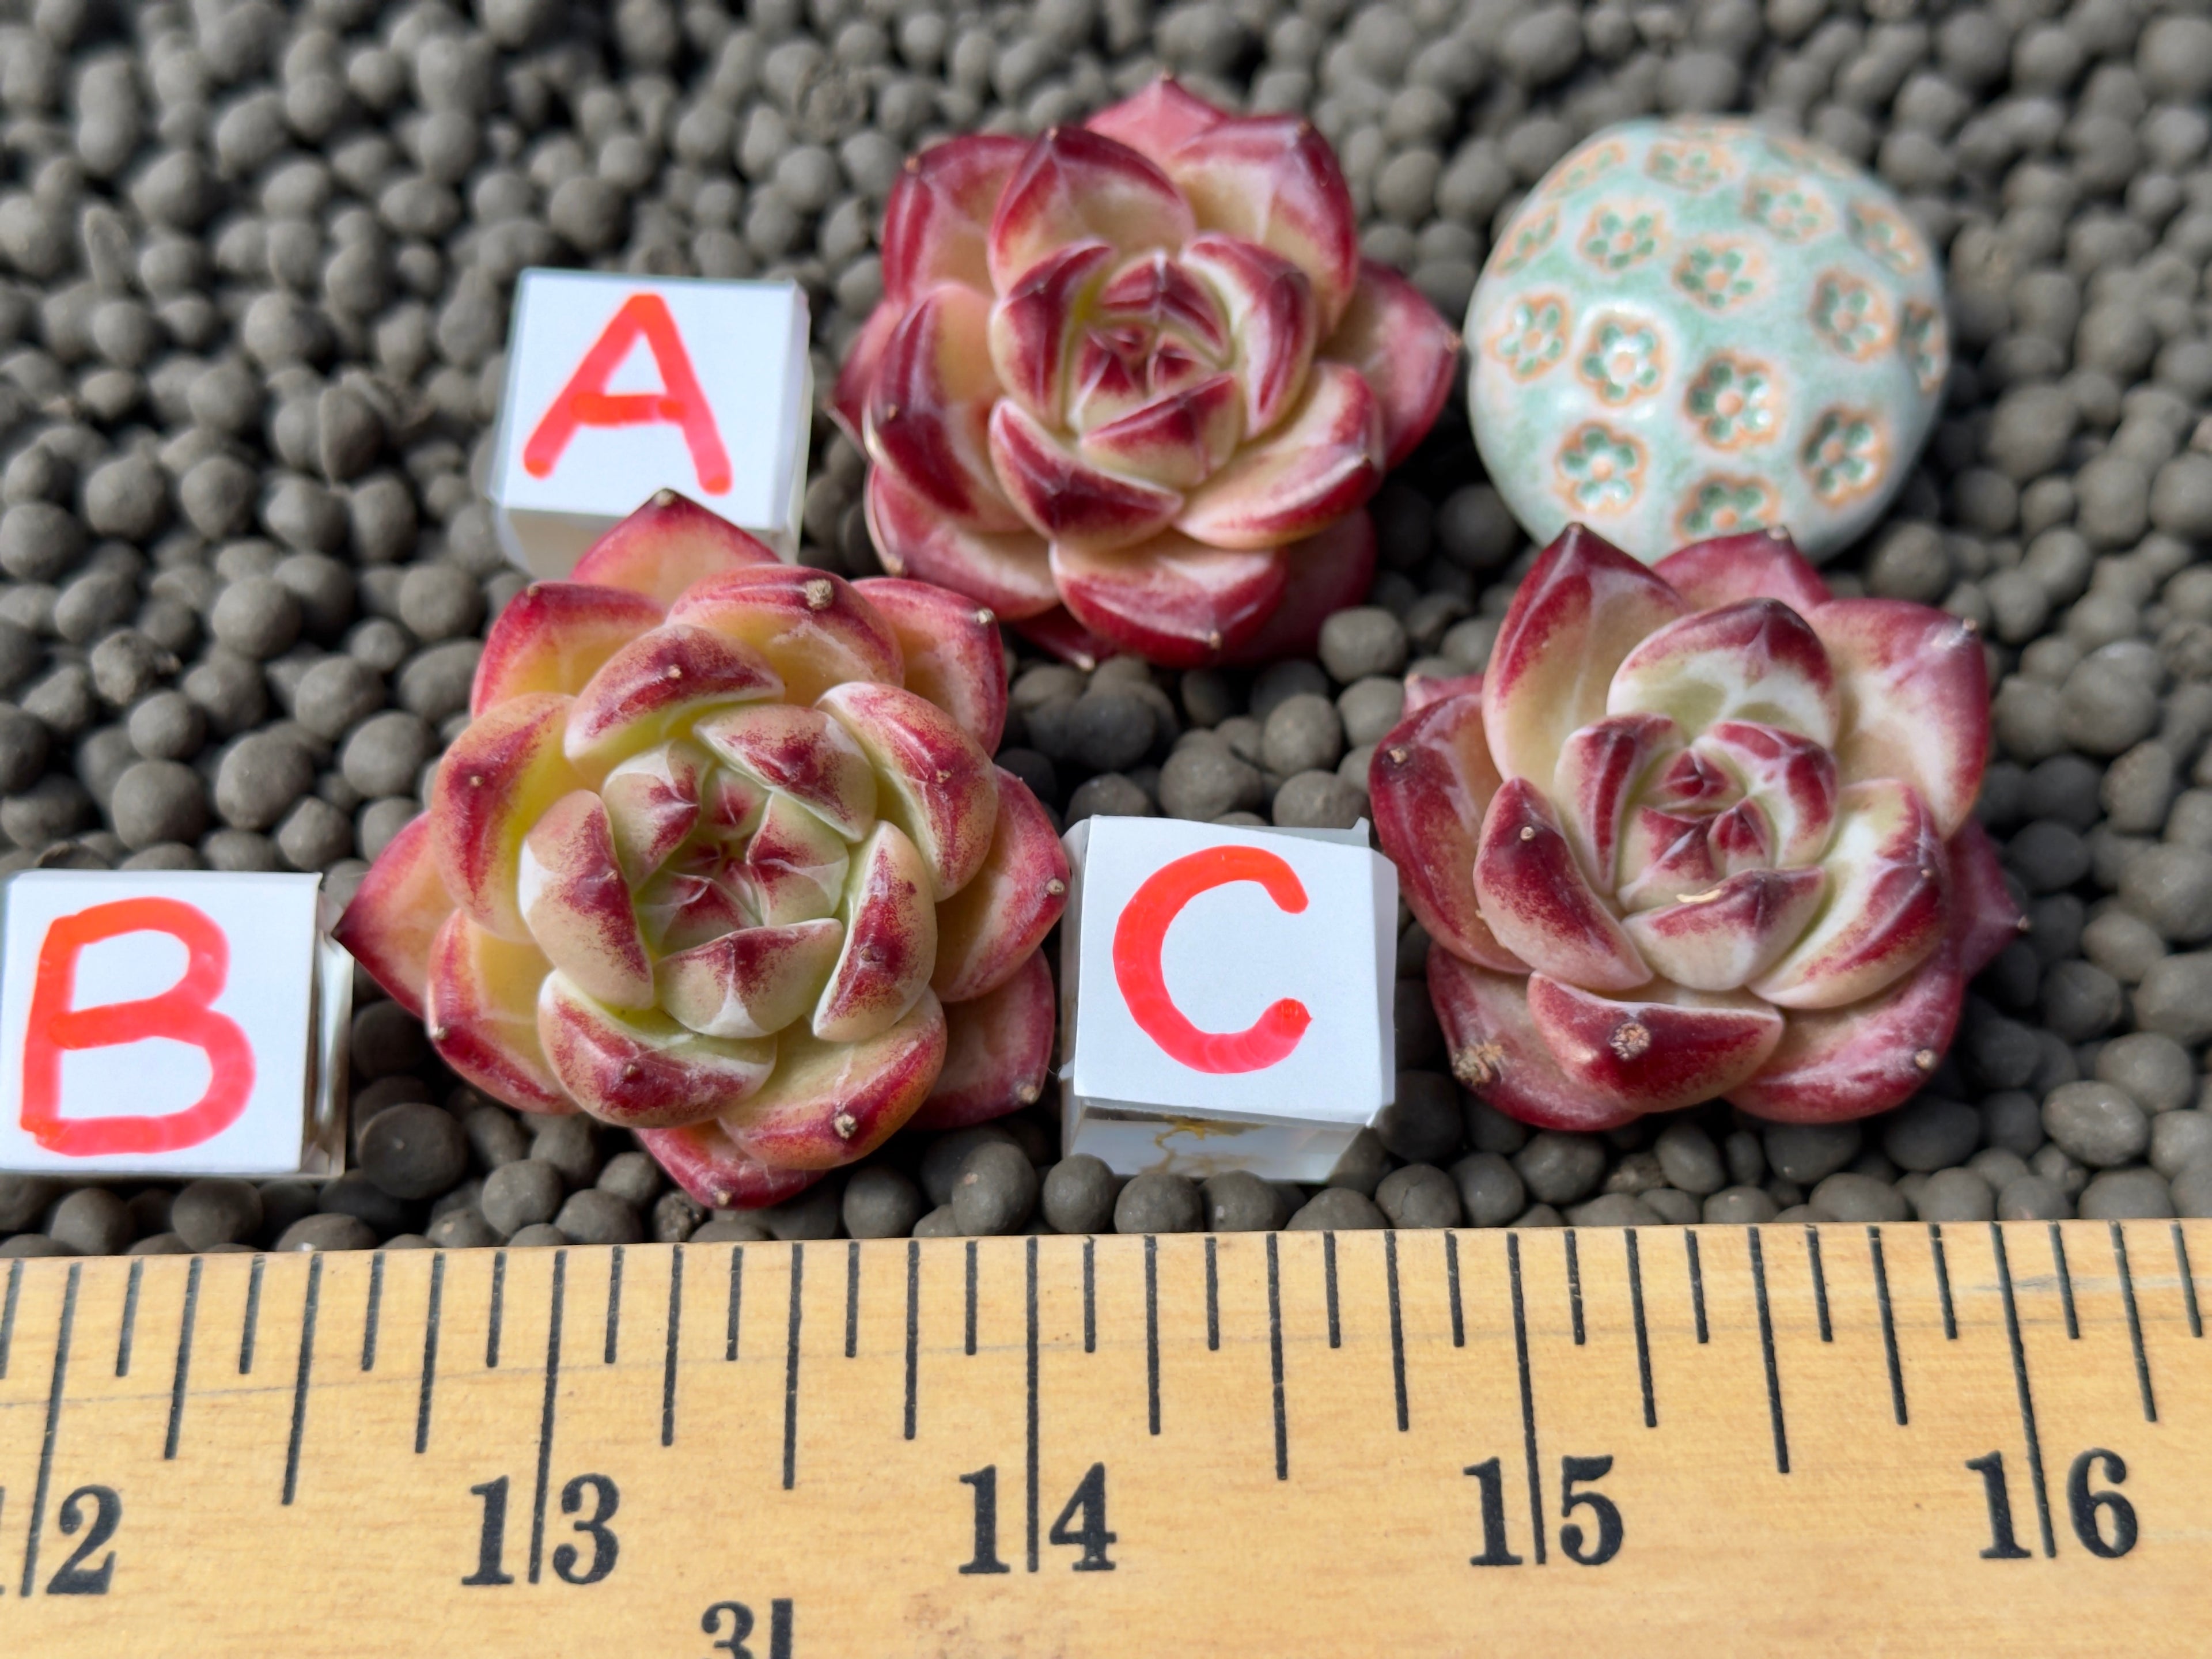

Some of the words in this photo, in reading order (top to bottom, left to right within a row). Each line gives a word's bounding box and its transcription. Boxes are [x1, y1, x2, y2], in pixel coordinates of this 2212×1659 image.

[523, 293, 732, 496] A
[20, 896, 256, 1157] B
[1112, 844, 1312, 1074] C
[0, 1484, 123, 1595] 2
[461, 1473, 620, 1586] 13
[959, 1462, 1116, 1574] 14
[1463, 1455, 1624, 1566] 15
[1965, 1448, 2139, 1559] 16
